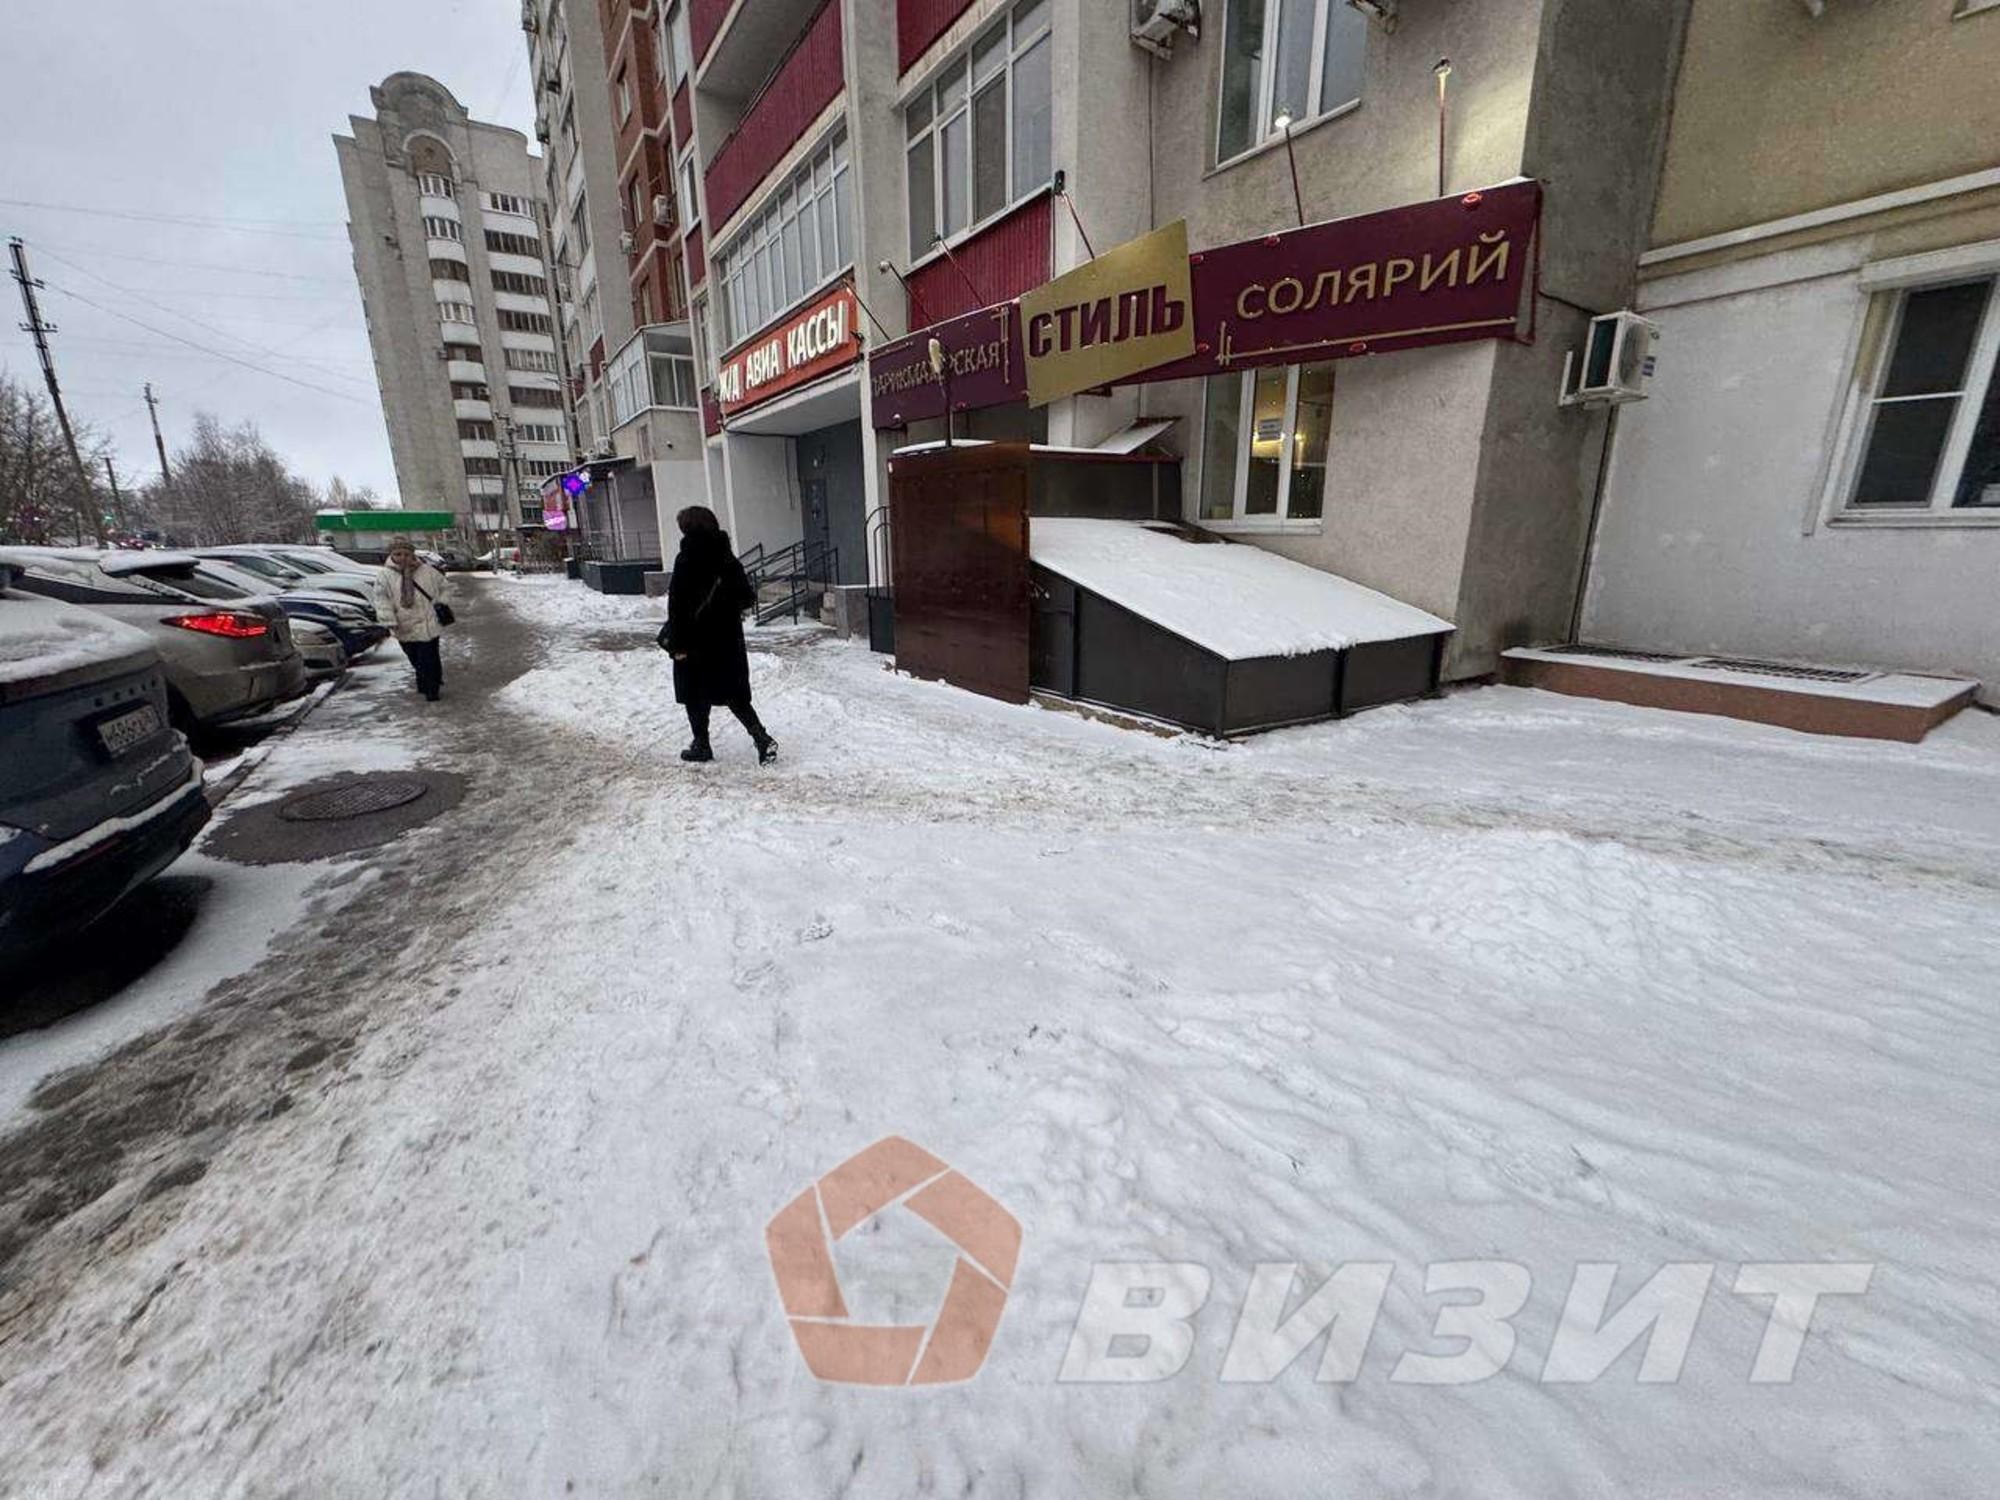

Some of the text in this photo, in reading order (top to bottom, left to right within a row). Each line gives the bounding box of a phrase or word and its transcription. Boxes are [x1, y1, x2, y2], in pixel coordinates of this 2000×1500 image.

[1236, 229, 1510, 320] СОЛЯРИЙ
[745, 339, 782, 391] АВИА
[786, 299, 847, 369] КАССЫ
[1028, 284, 1186, 358] СТИЛЬ
[873, 340, 1001, 397] ПАРИКМАСКАЯ
